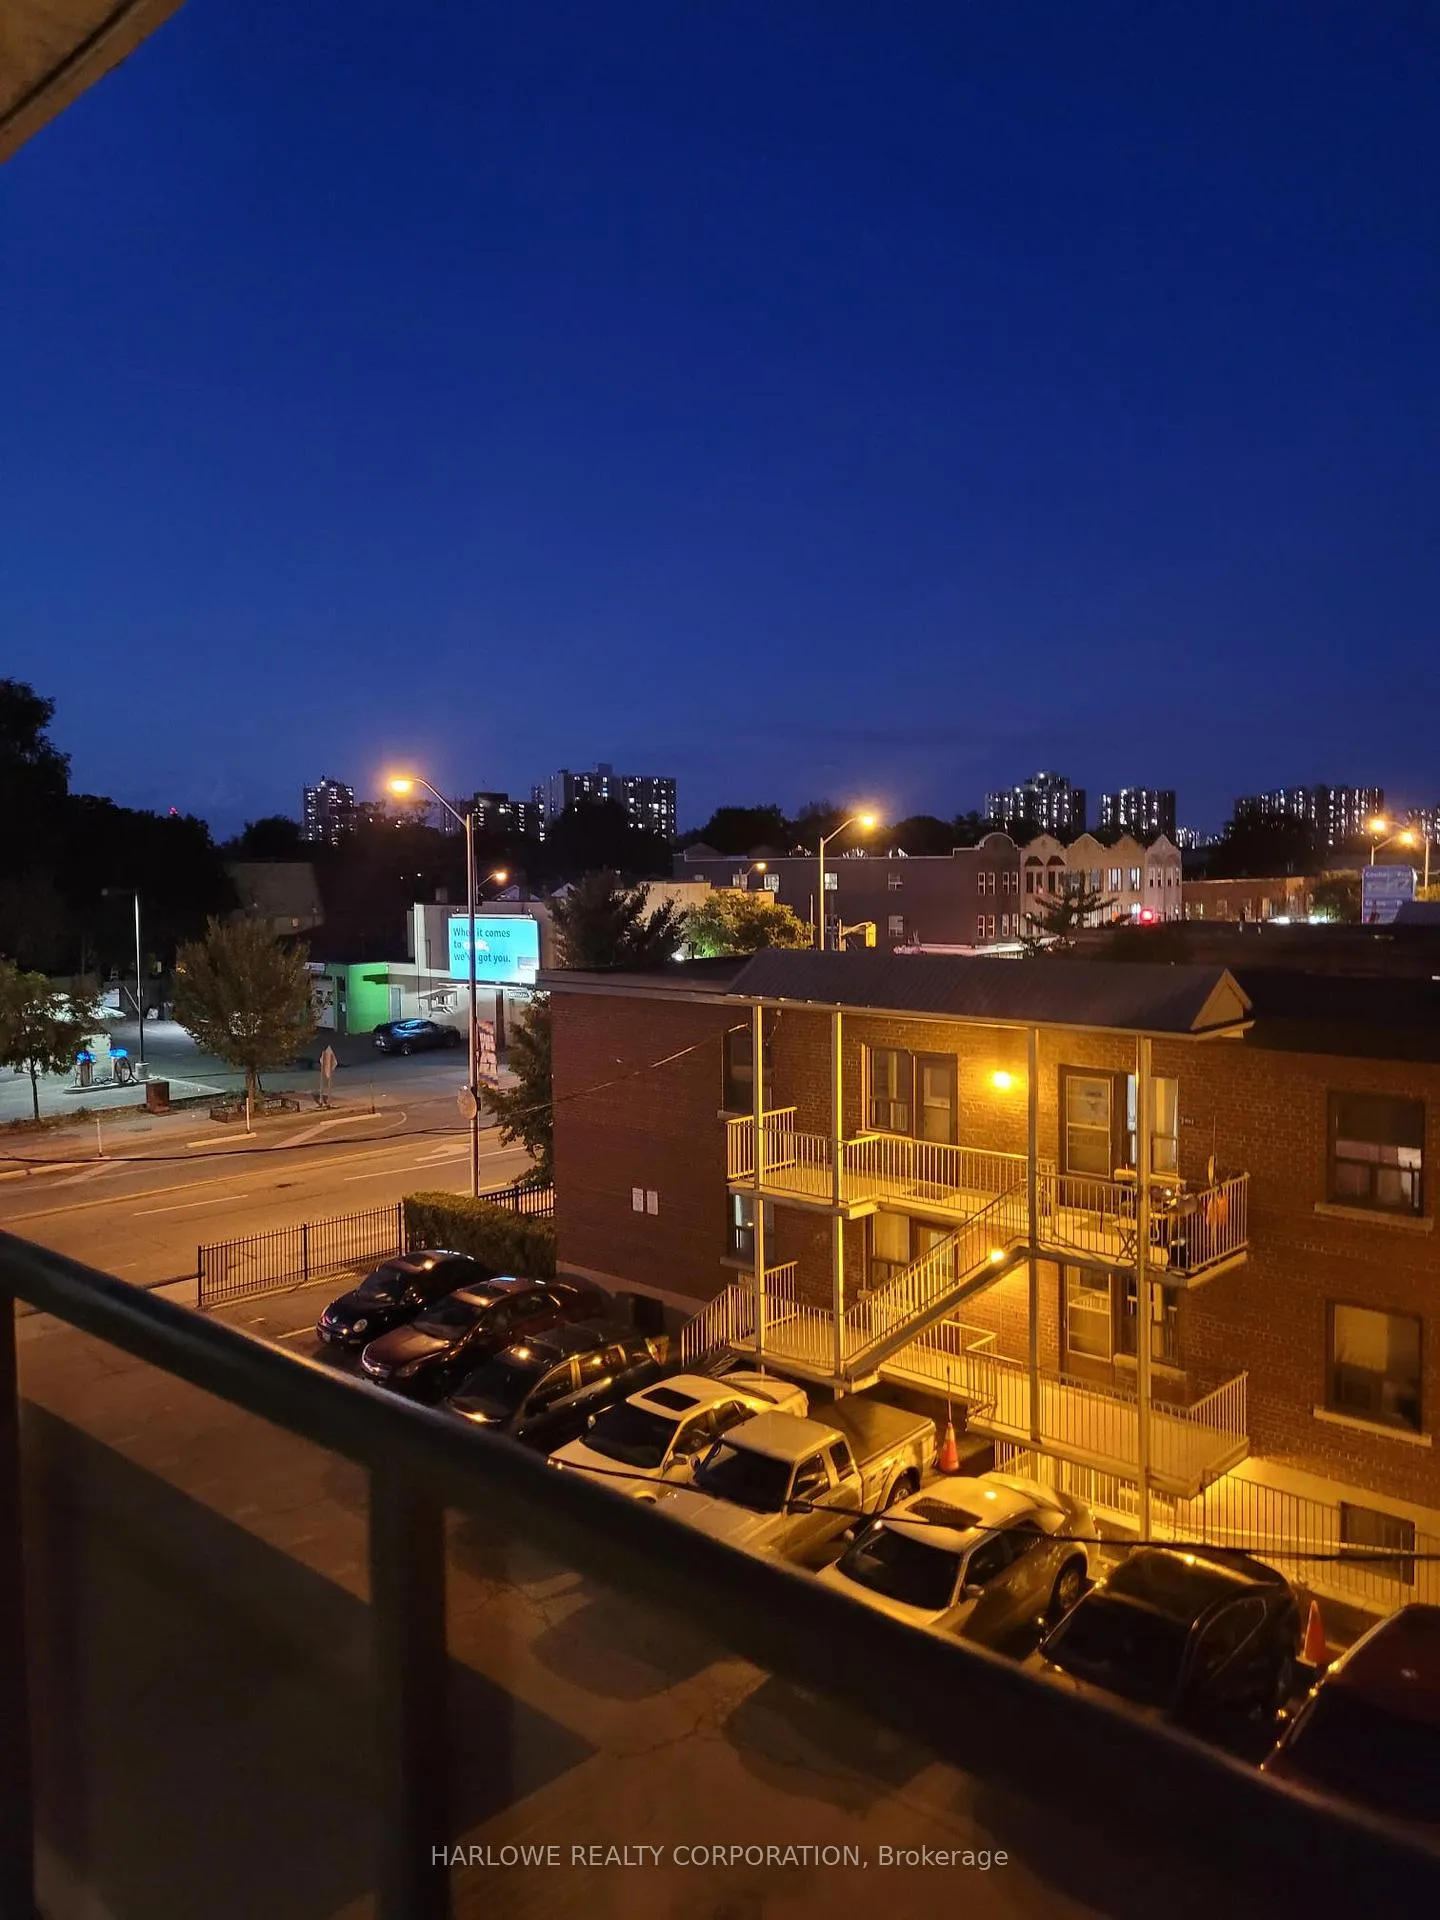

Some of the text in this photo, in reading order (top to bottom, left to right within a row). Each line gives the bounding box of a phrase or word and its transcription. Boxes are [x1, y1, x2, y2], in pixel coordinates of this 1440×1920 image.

[453, 927, 511, 938] Whe it comes
[453, 940, 462, 949] to
[453, 952, 475, 961] we'v
[478, 953, 491, 965] got
[493, 954, 511, 965] you.
